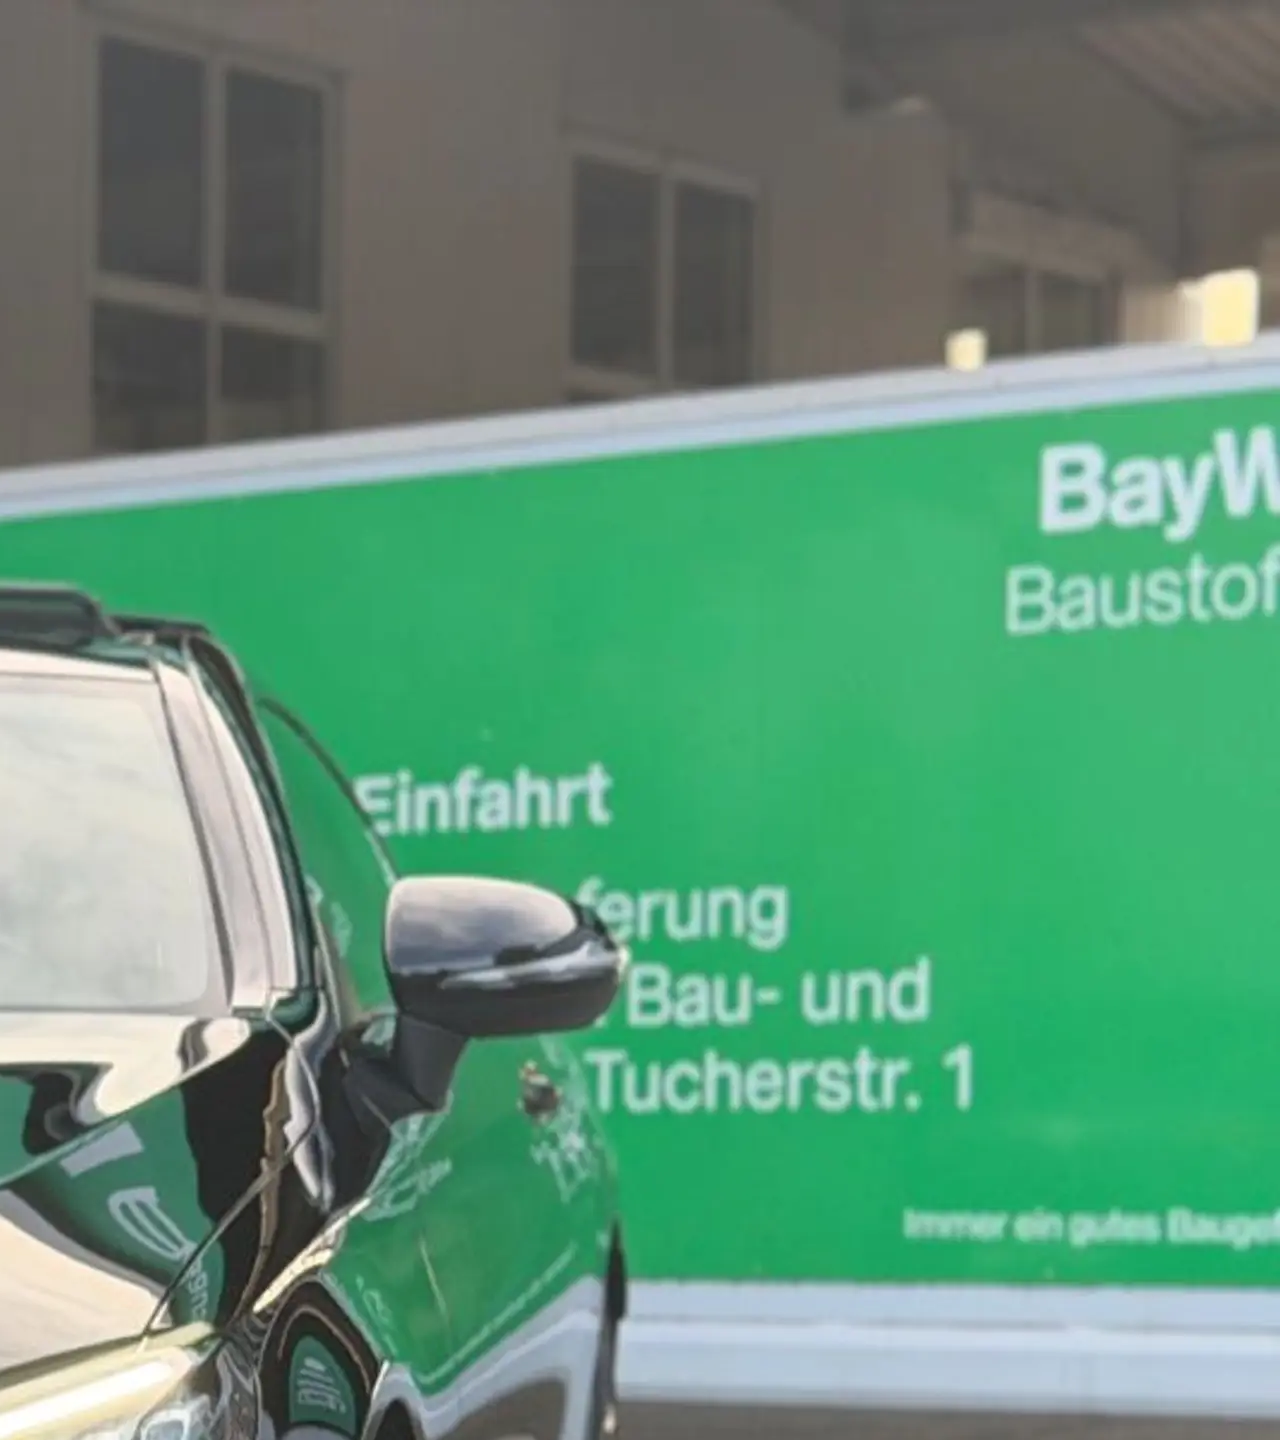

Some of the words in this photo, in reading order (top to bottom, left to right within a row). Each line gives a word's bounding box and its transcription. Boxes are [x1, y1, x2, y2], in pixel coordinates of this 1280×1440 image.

[1040, 424, 1280, 541] BayW
[353, 761, 613, 836] Einfahrt
[626, 963, 780, 1029] Bau-
[801, 955, 932, 1024] und
[583, 1044, 922, 1114] Tucherstr.
[943, 1043, 973, 1110] 1
[903, 1206, 1008, 1240] Immer
[1013, 1205, 1064, 1242] ein
[1068, 1206, 1162, 1250] gutes
